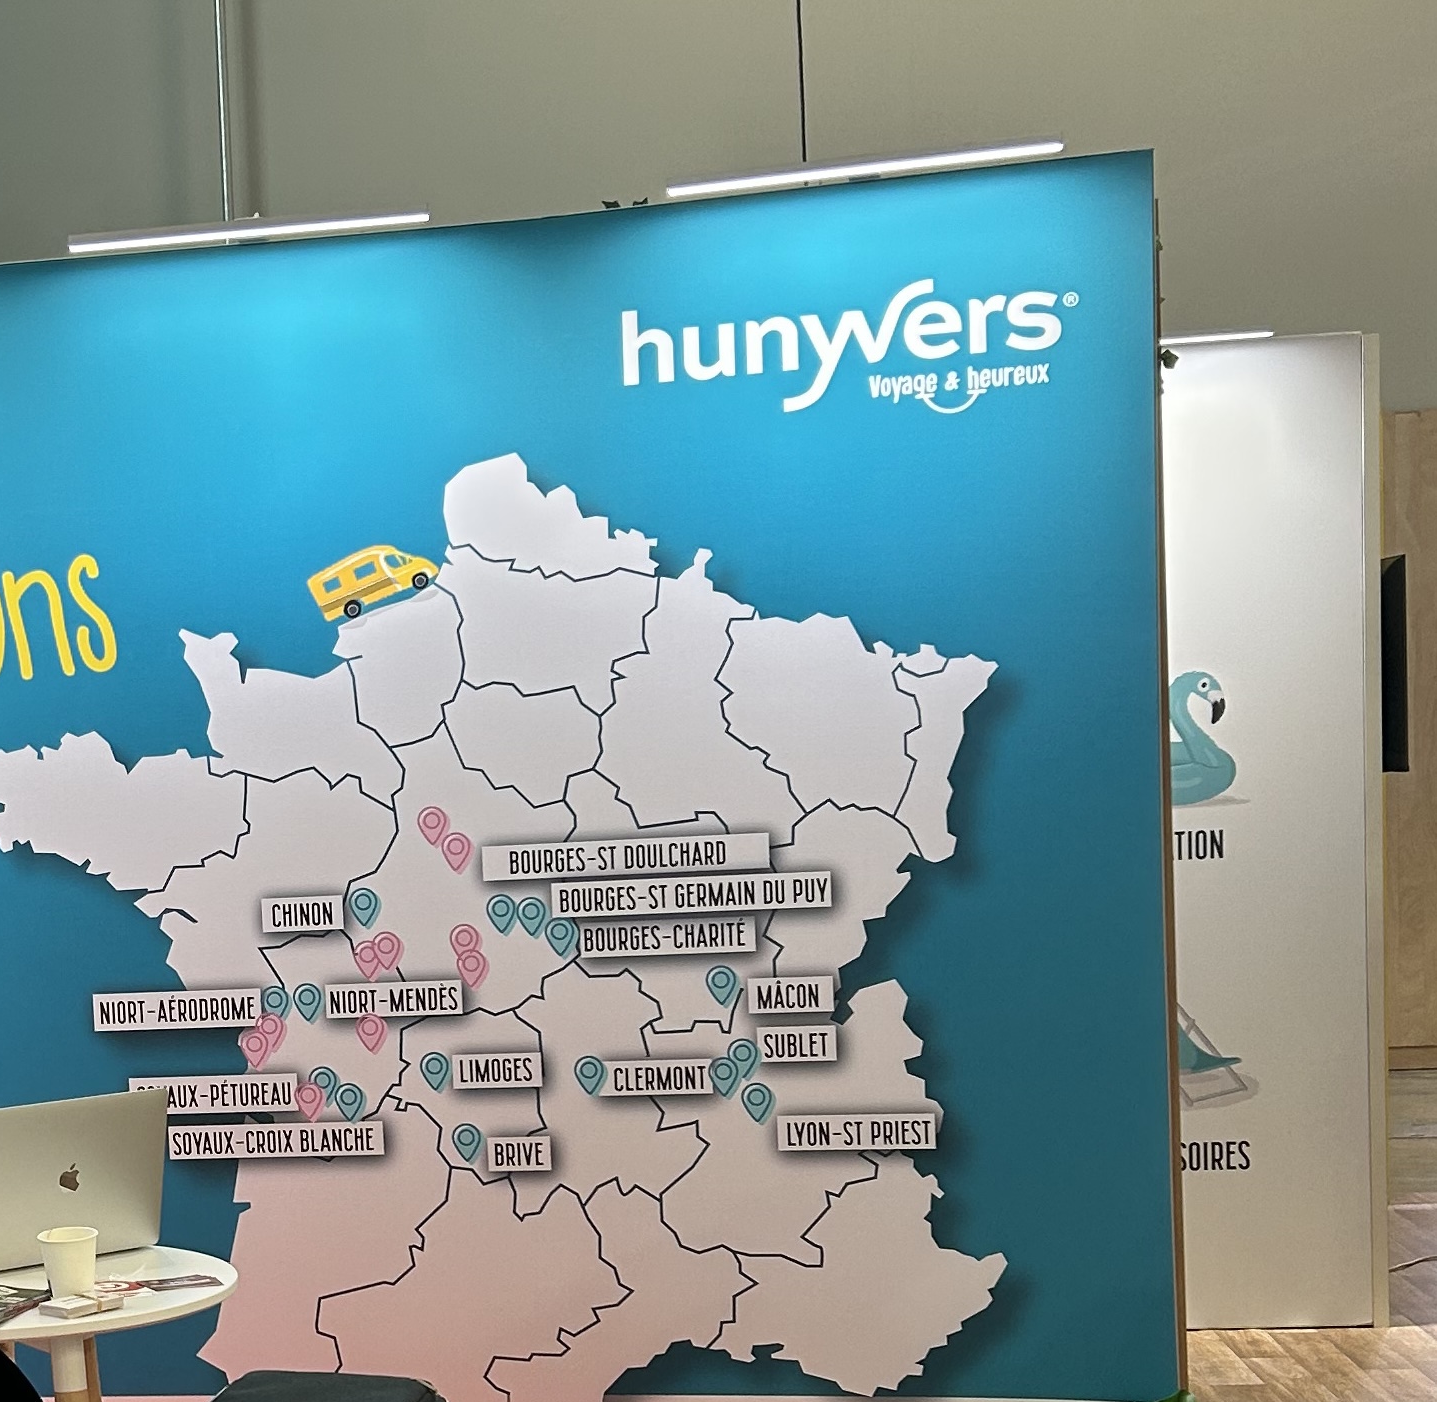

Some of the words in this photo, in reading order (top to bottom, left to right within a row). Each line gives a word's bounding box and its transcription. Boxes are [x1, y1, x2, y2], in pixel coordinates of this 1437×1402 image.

[869, 372, 937, 404] Voyage
[945, 371, 960, 391] &
[967, 363, 1050, 393] heureux
[509, 845, 616, 875] BOURGES-ST
[624, 840, 727, 870] DOULCHARD
[1174, 829, 1224, 860] TION
[559, 885, 667, 914] BOURGES-ST
[674, 881, 756, 909] GERMAIN
[764, 879, 788, 905] DU
[793, 877, 828, 903] PUY
[271, 902, 333, 928] CHINON
[583, 918, 746, 953] BOURGES-CHARITÉ
[99, 993, 255, 1025] NIORT-AÉRODROME
[329, 983, 458, 1014] NIORT-MENDÈS
[757, 980, 820, 1010] MÂCON
[764, 1032, 828, 1059] SUBLET
[459, 1058, 533, 1084] LIMOGES
[613, 1065, 706, 1092] CLERMONT
[137, 1080, 292, 1108] AUX-PÉTUREAU
[172, 1129, 293, 1156] SOYAUX-CROIX
[300, 1127, 375, 1153] BLANCHE
[786, 1121, 864, 1147] LYON-ST
[871, 1119, 932, 1146] PRIEST
[494, 1141, 544, 1167] BRIVE
